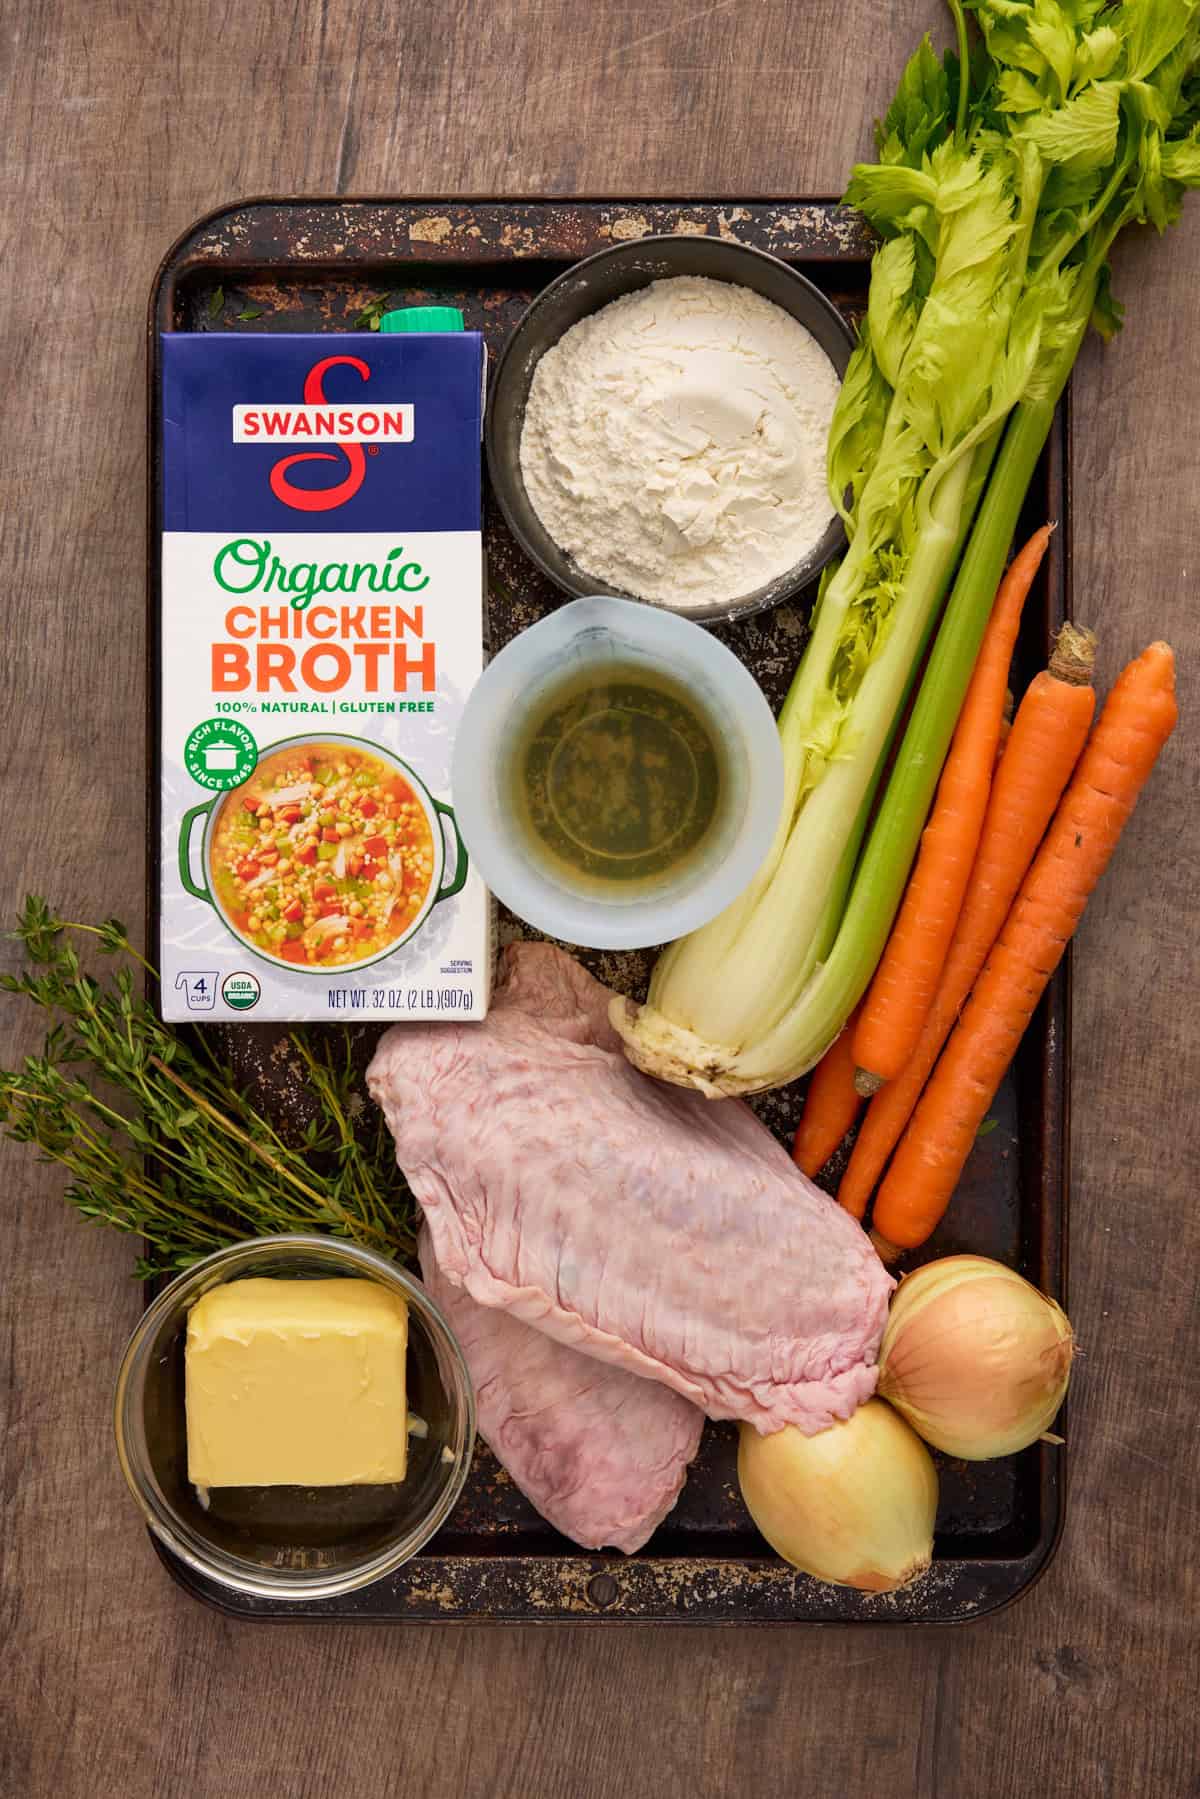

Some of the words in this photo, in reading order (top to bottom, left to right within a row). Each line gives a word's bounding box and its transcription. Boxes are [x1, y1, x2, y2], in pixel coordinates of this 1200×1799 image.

[243, 412, 403, 436] SWANSON
[213, 538, 430, 611] Organic
[224, 605, 424, 639] CHICKEN
[211, 642, 436, 693] BROTH
[215, 702, 257, 713] 100%
[261, 702, 328, 713] NATURAL
[339, 702, 395, 713] GLUTEN
[399, 702, 434, 713] FREE
[188, 724, 212, 752] RICH
[213, 721, 254, 752] FLAVOR
[190, 763, 223, 789] SINCE
[193, 977, 208, 994] 4
[231, 981, 252, 990] USDA
[328, 990, 347, 1008] NET
[350, 990, 370, 1008] WT.
[372, 990, 385, 1008] 32
[388, 990, 404, 1008] OZ.
[407, 989, 418, 1010] (2
